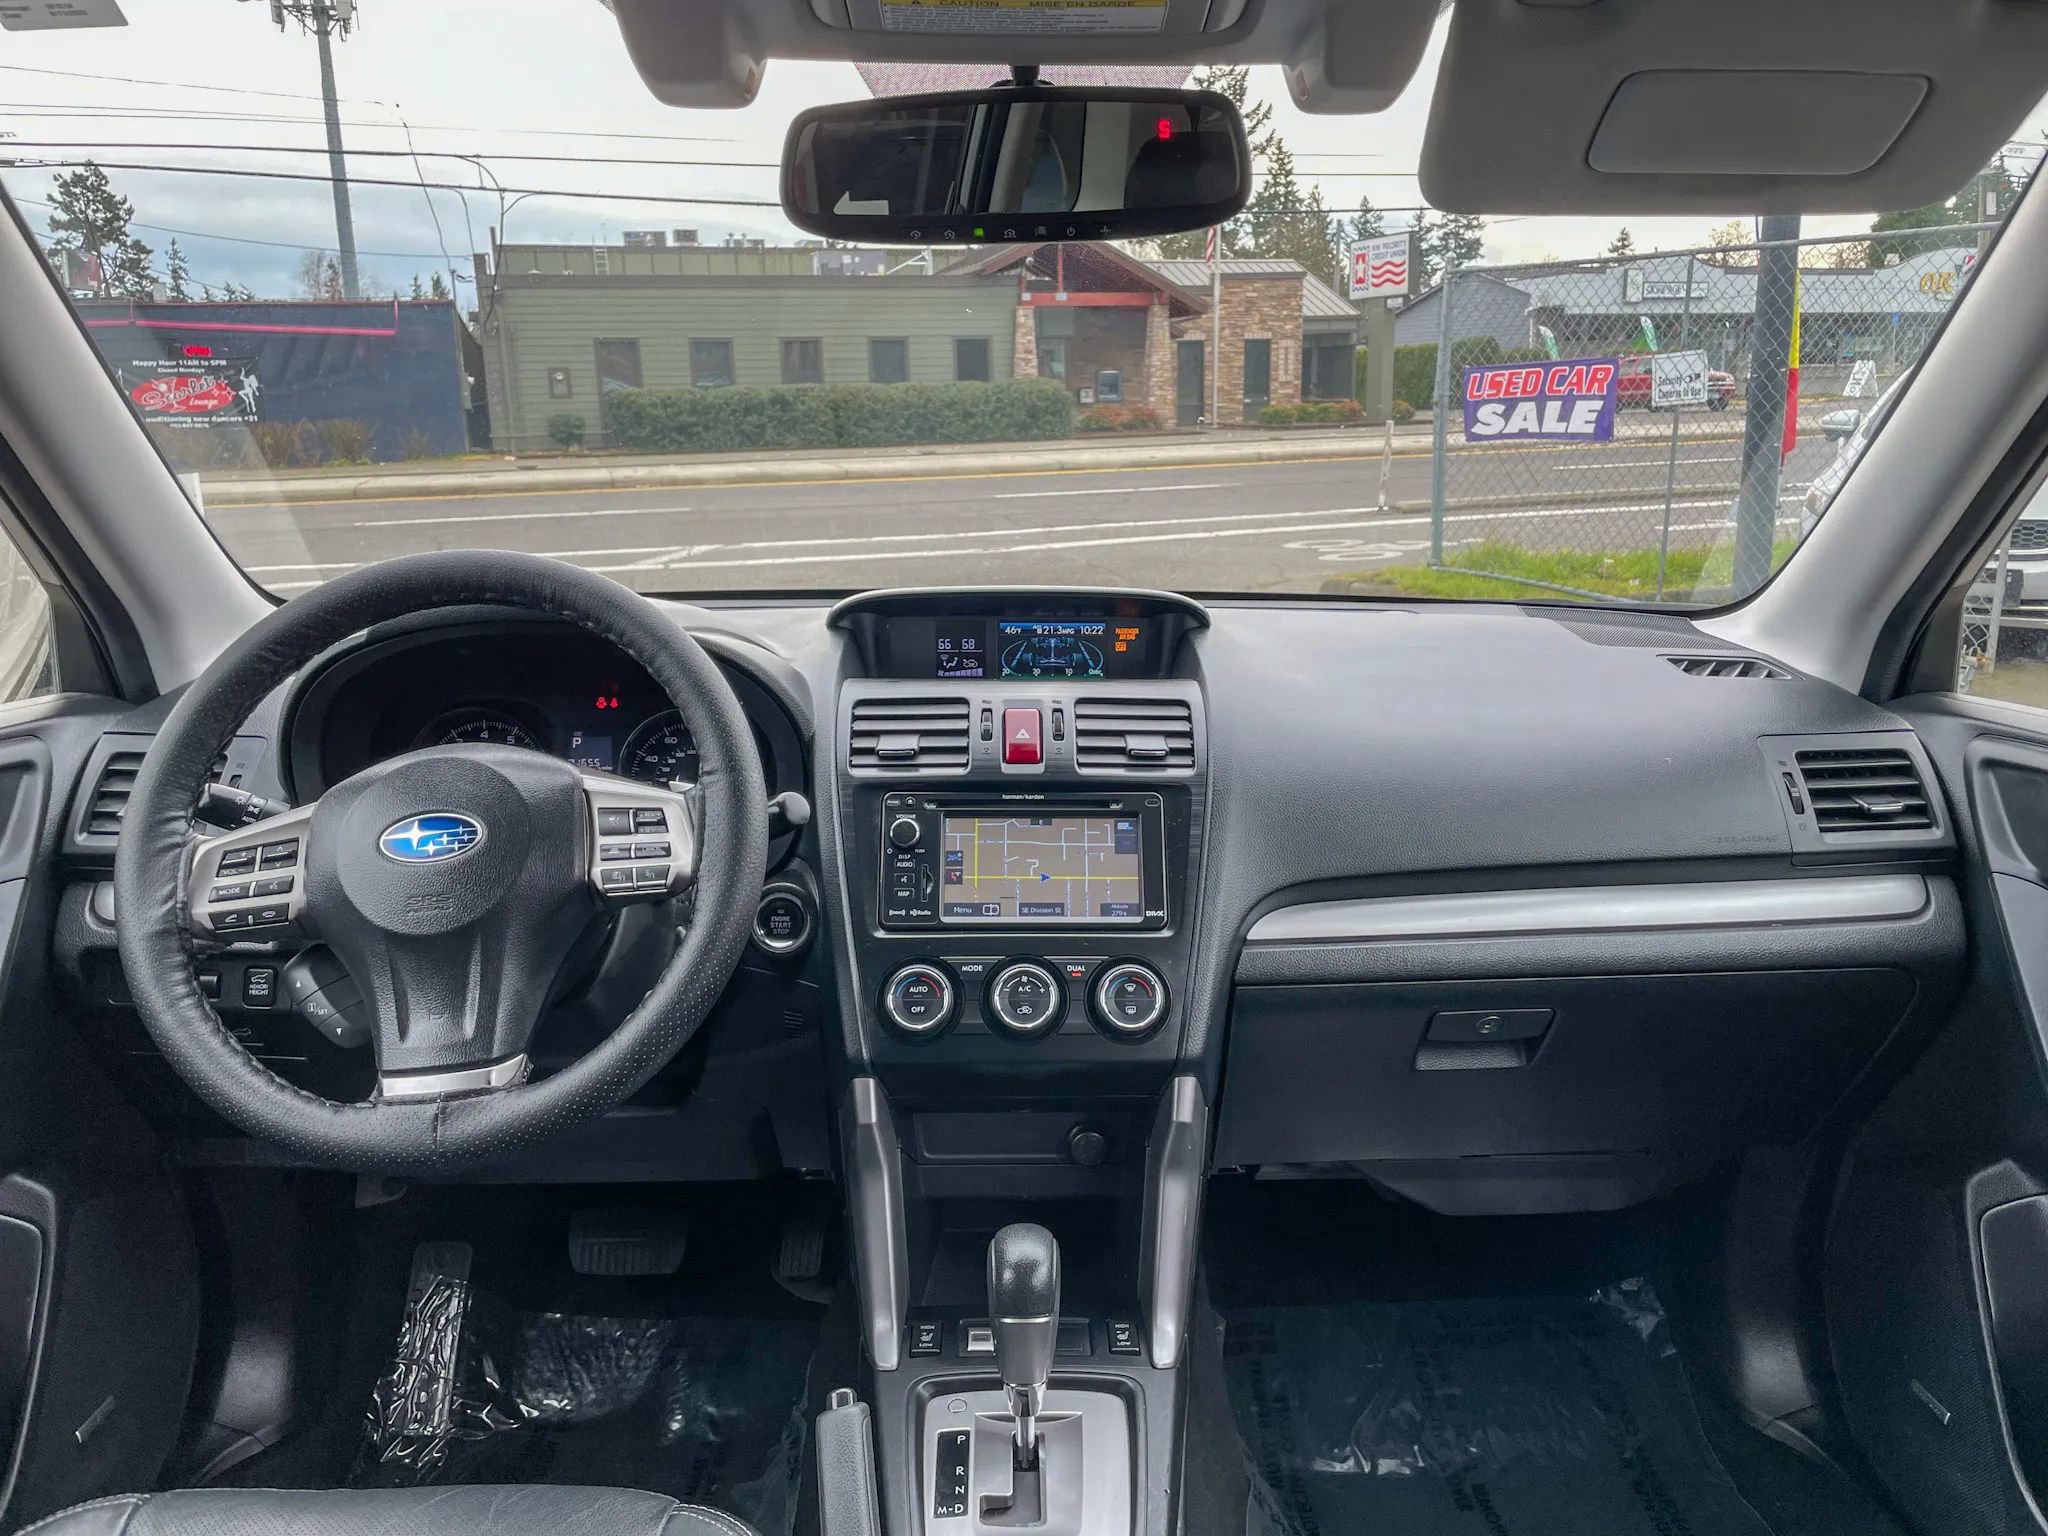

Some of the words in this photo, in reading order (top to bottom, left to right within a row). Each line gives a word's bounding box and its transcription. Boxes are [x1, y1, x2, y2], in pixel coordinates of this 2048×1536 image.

[1158, 119, 1171, 139] S
[1920, 272, 1956, 294] OK
[1467, 367, 1543, 401] USED
[1545, 365, 1615, 396] CAR
[1658, 375, 1682, 388] Security
[141, 375, 216, 409] Scarlet
[1658, 389, 1681, 399] Cameras
[1691, 385, 1701, 397] Use
[189, 398, 219, 410] Lounge
[1470, 400, 1604, 436] SALE
[1080, 625, 1104, 635] 10:22
[937, 638, 951, 650] 66
[962, 638, 975, 650] 68
[1116, 642, 1127, 651] OFF
[479, 731, 489, 739] 4
[506, 736, 515, 745] 5
[572, 737, 581, 749] P
[645, 755, 658, 763] 40
[218, 887, 241, 896] MODE
[953, 906, 973, 914] Menu
[961, 964, 983, 972] MODE
[1067, 964, 1086, 972] DUAL
[908, 985, 929, 993] AUTO
[1017, 985, 1032, 993] A/C
[911, 1006, 926, 1014] OFF
[957, 1435, 967, 1445] P
[955, 1466, 965, 1476] R
[955, 1485, 965, 1495] N
